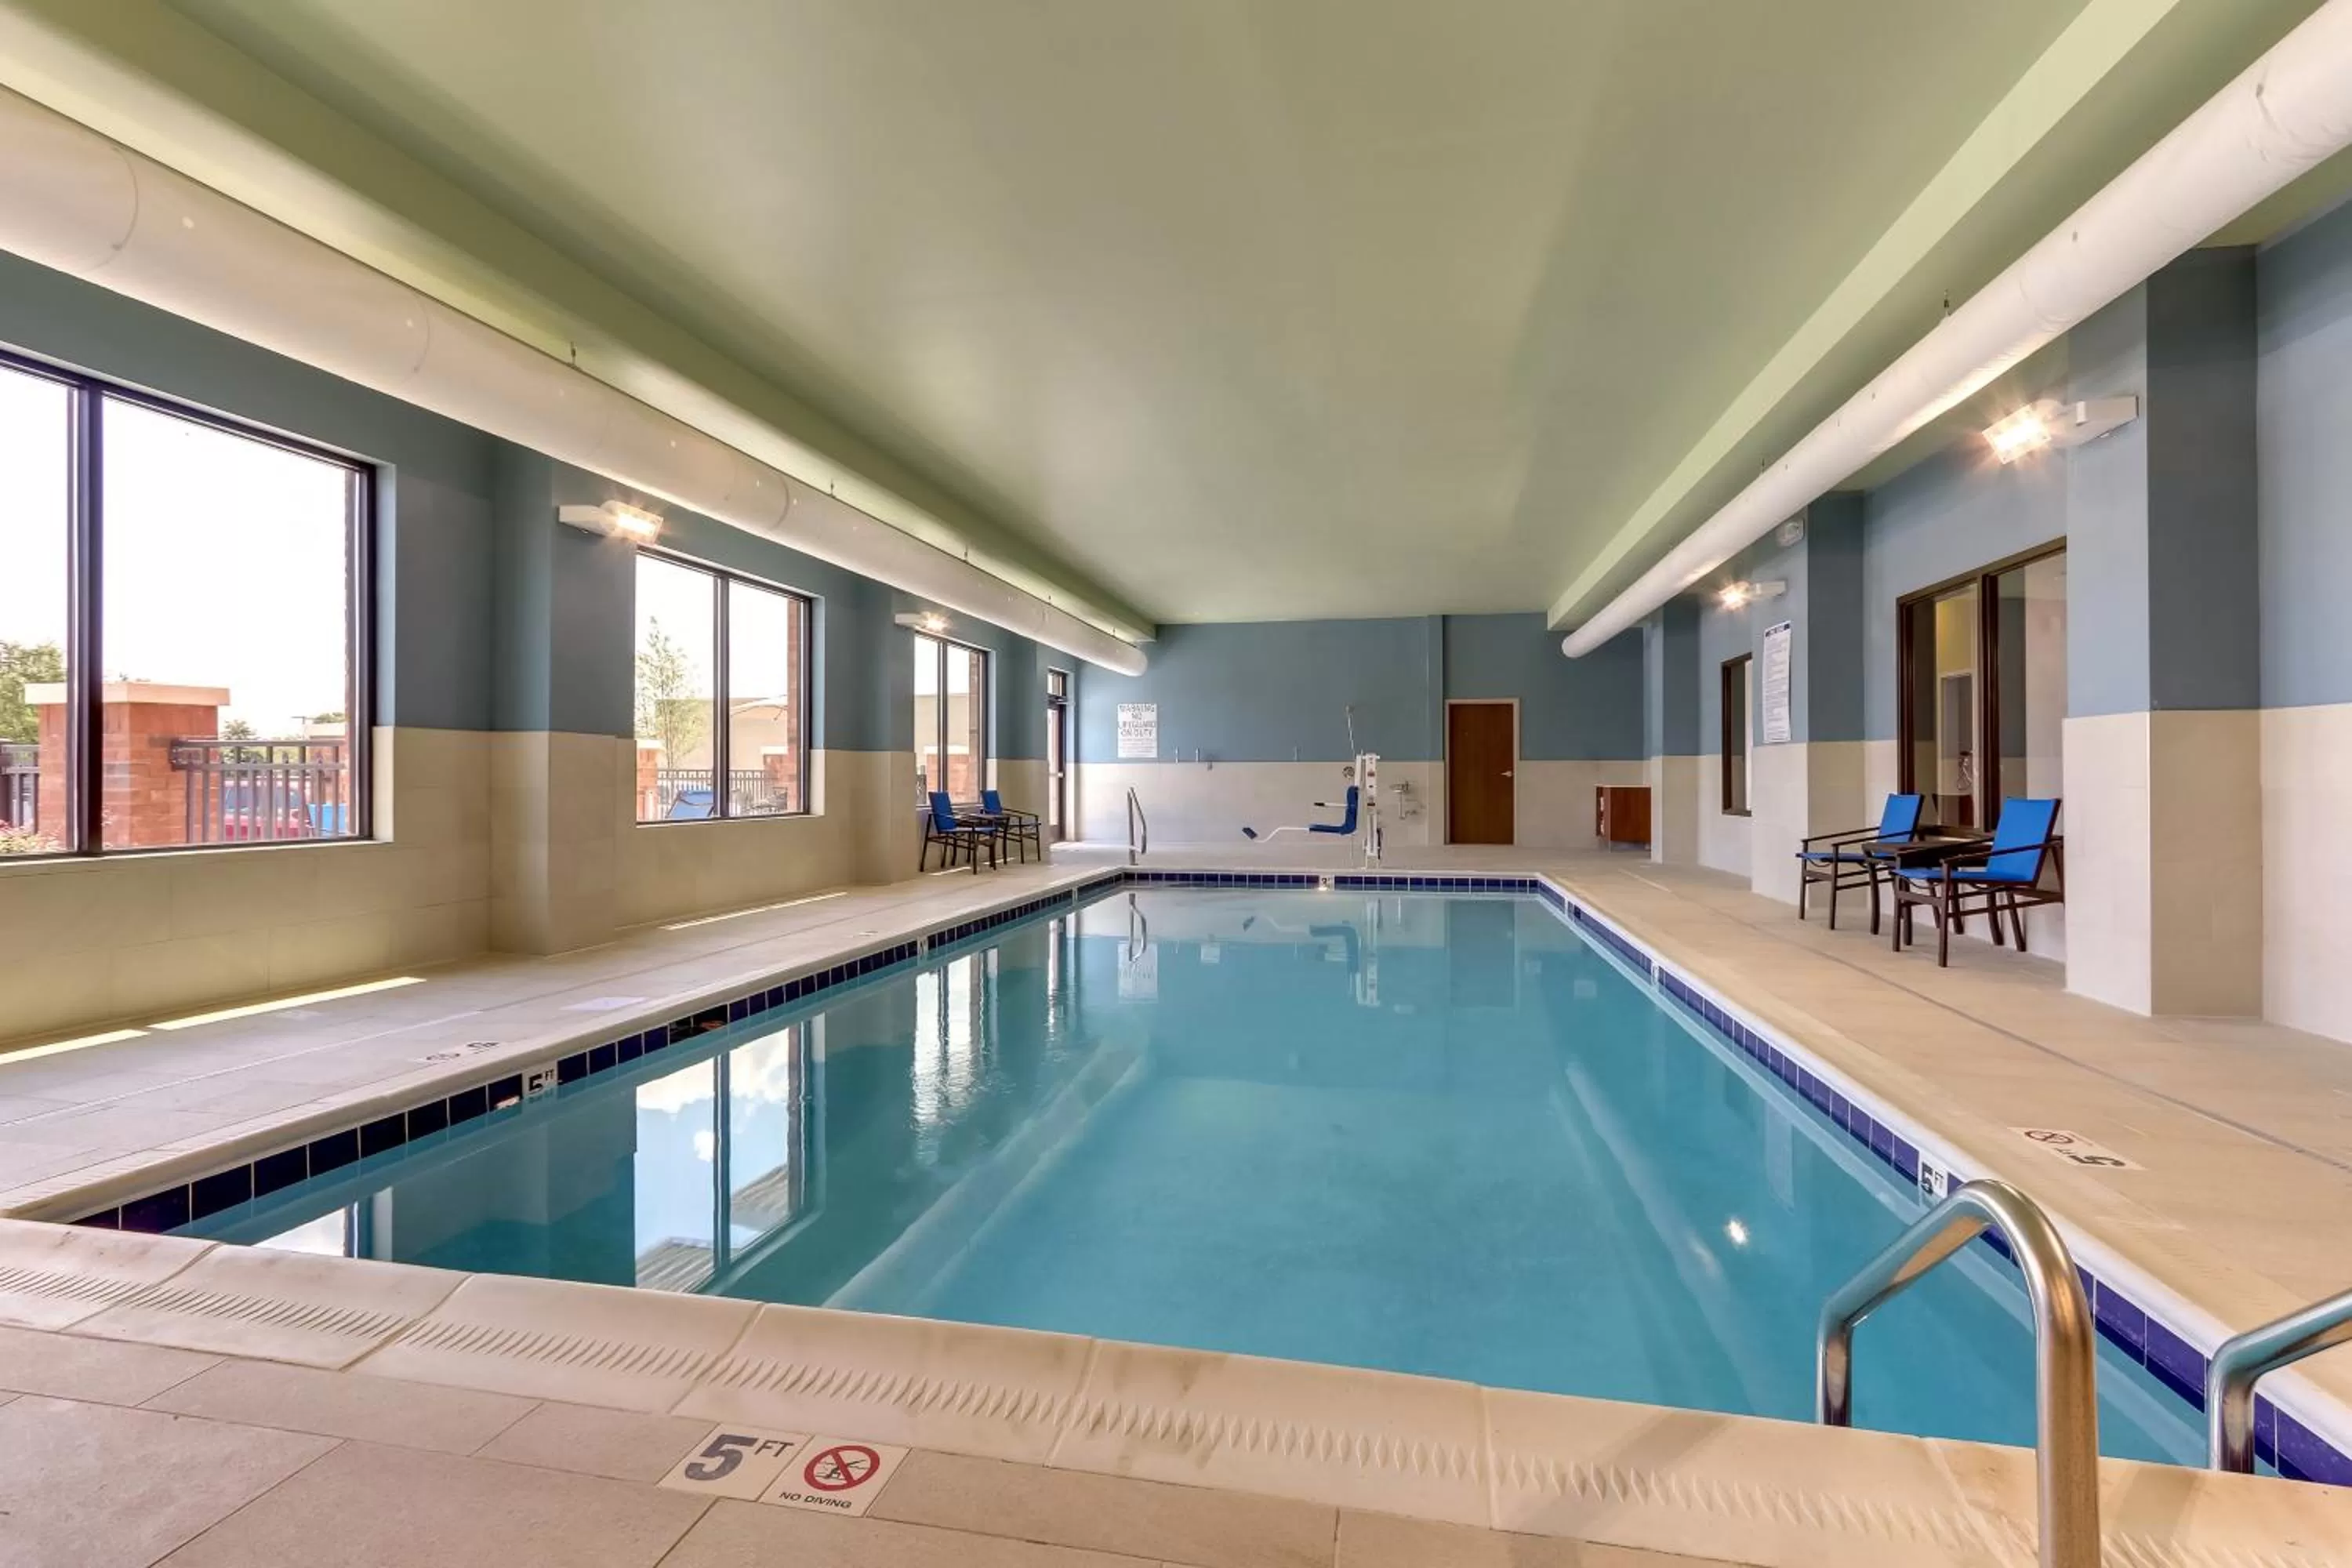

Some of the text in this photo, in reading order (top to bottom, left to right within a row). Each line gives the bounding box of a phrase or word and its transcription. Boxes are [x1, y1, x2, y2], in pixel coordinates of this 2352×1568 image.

[528, 1073, 544, 1094] 5
[1921, 1162, 1934, 1196] 5
[684, 1433, 795, 1481] 5 FT
[779, 1490, 853, 1509] NO DIVING
